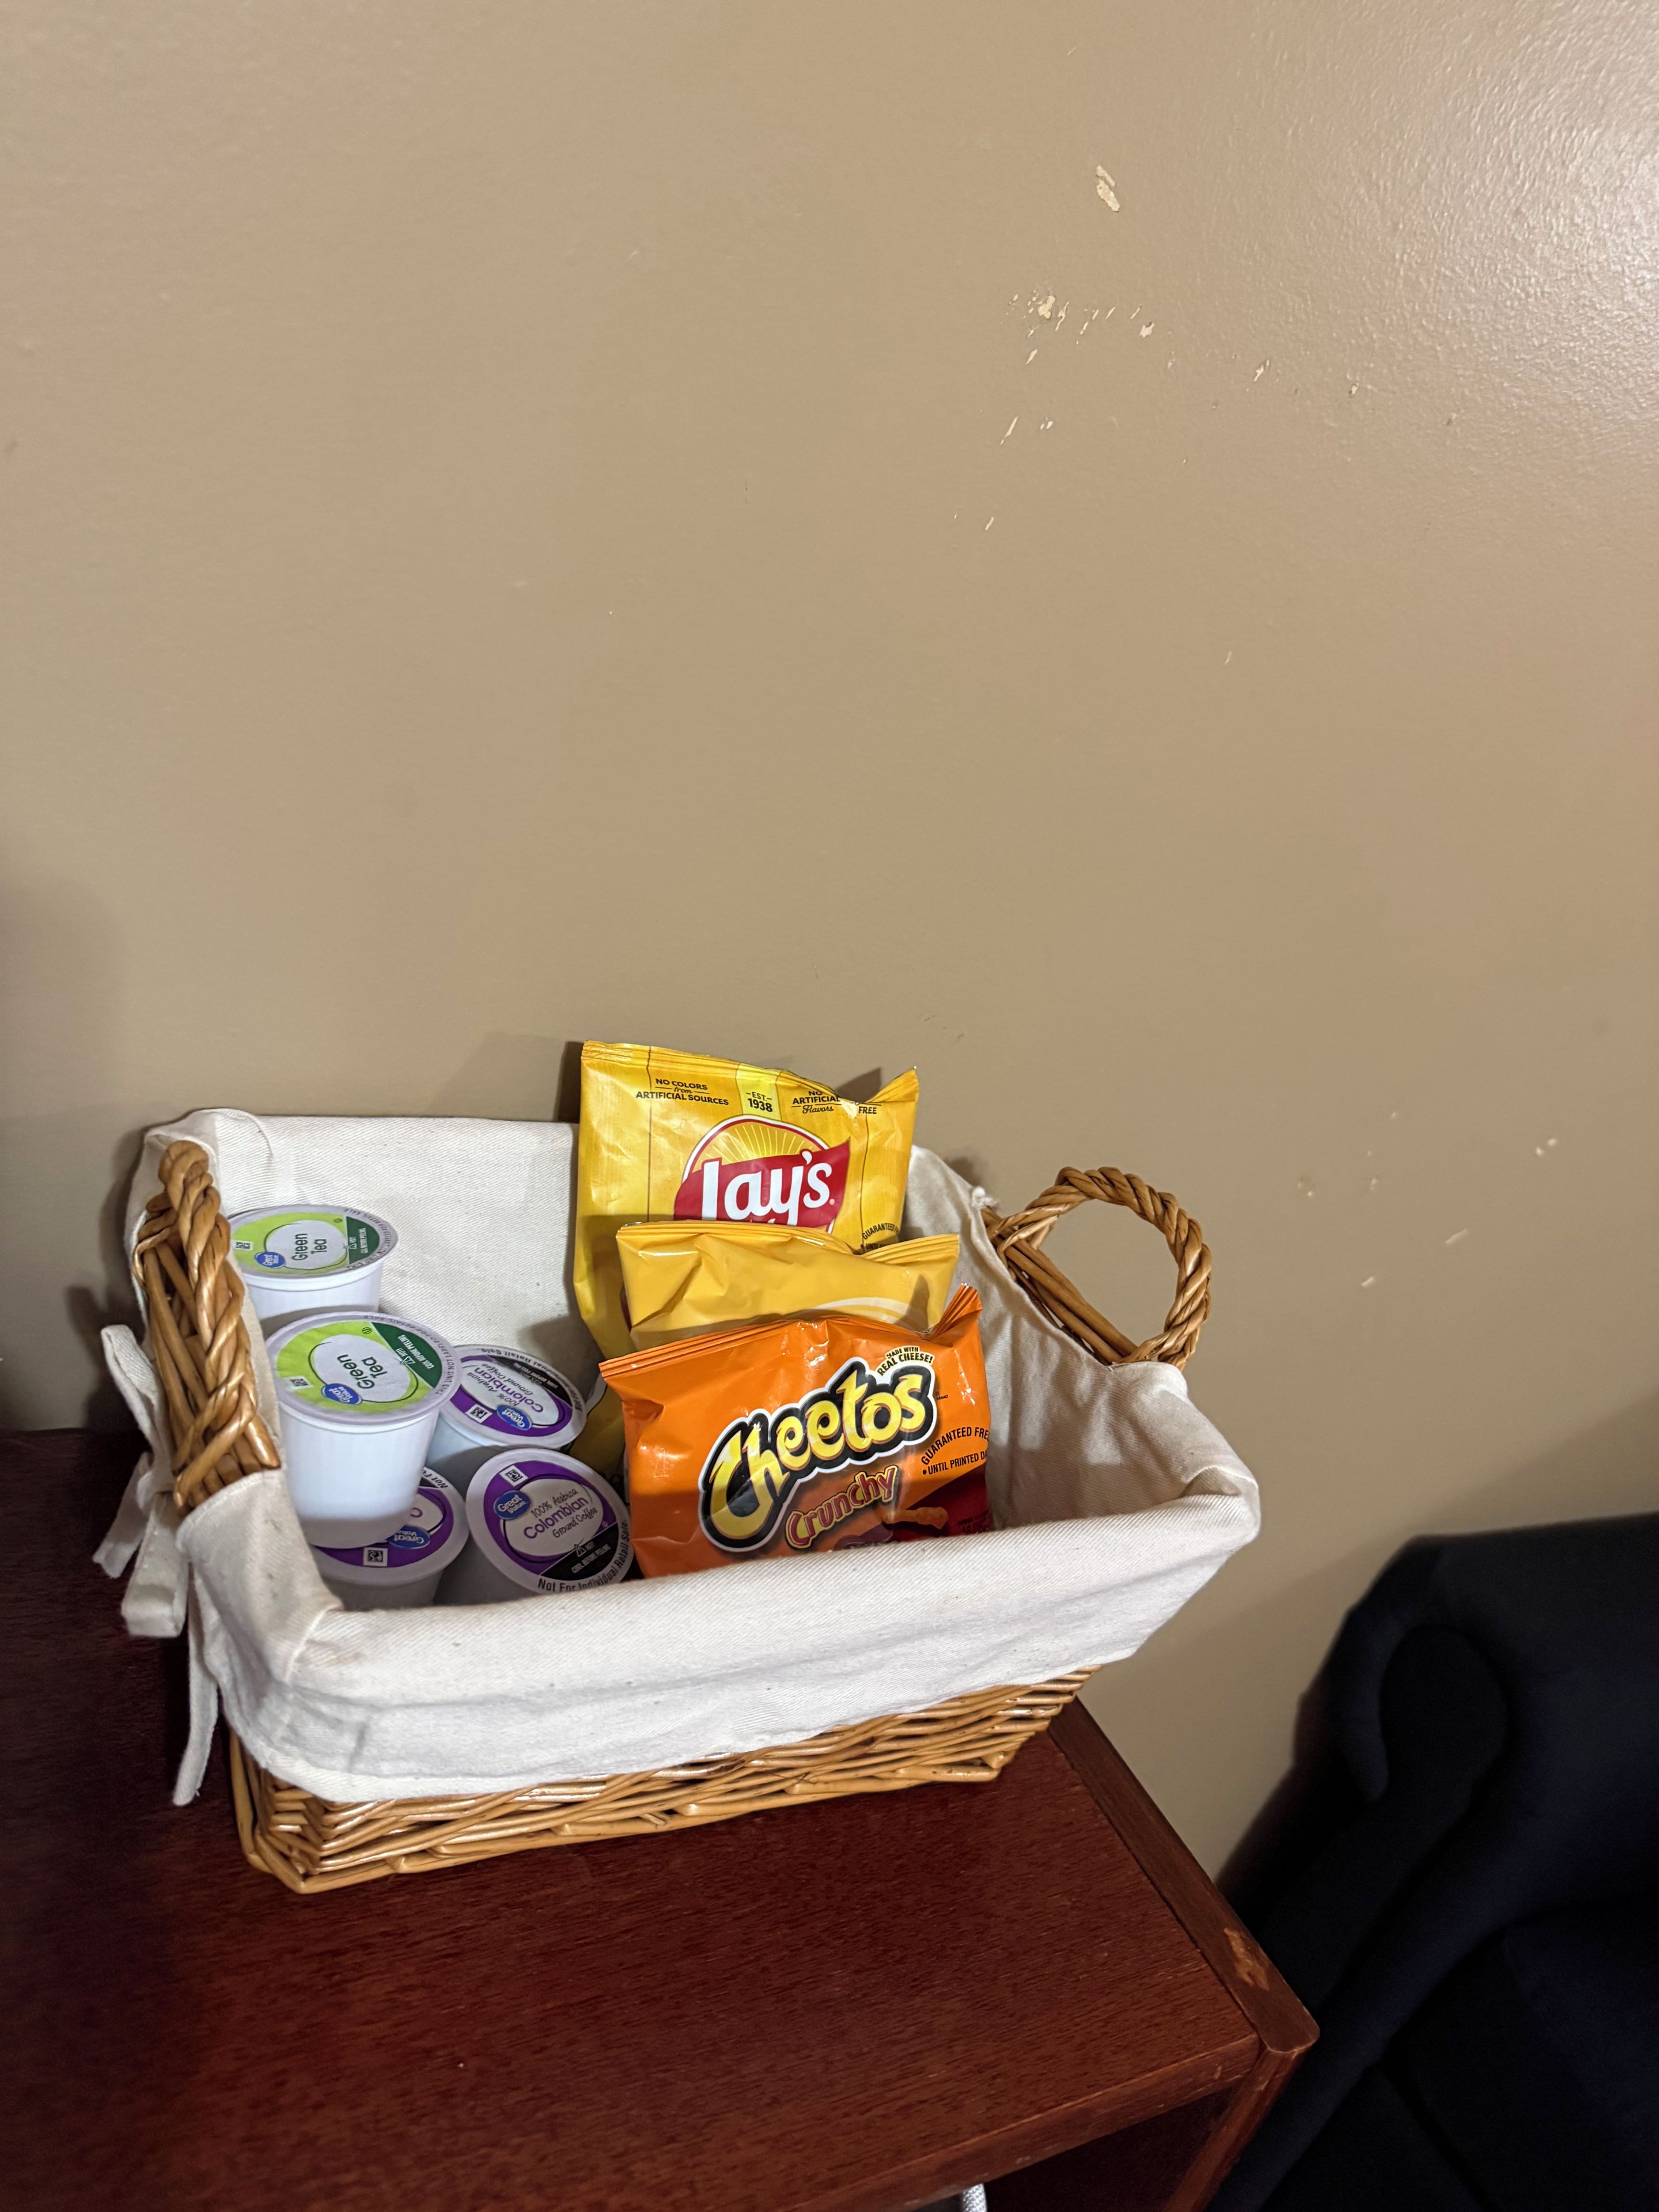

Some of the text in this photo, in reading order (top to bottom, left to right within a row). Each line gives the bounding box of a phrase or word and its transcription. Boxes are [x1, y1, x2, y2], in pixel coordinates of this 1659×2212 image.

[671, 1081, 708, 1090] COLORS
[636, 1091, 729, 1105] ARTIFICIAL SOURCES
[748, 1098, 773, 1112] 1938
[792, 1094, 841, 1104] ARTIFICIAL
[802, 1105, 834, 1114] Flavors
[858, 1106, 877, 1114] FREE
[862, 1222, 895, 1240] GUARANTEED
[291, 1233, 308, 1260] Green
[310, 1238, 327, 1255] Tea
[886, 1348, 903, 1359] MADE
[336, 1354, 375, 1389] Green
[361, 1357, 388, 1378] Tea
[446, 1359, 455, 1370] NOT
[877, 1353, 933, 1376] REAL CHEESE!
[467, 1372, 520, 1406] 100% Arabica
[474, 1367, 544, 1412] Colombian
[506, 1377, 533, 1395] Ground
[502, 1410, 525, 1428] Great
[709, 1369, 925, 1540] Cheetos
[921, 1426, 972, 1465] GUARANTEED
[927, 1461, 949, 1475] UNTIL
[950, 1453, 979, 1468] PRINTED
[431, 1476, 449, 1488] Not
[497, 1494, 523, 1512] Great
[531, 1500, 552, 1518] 100%
[786, 1466, 898, 1548] Crunchy
[523, 1497, 589, 1539] Colombian
[552, 1516, 579, 1538] Ground
[394, 1534, 425, 1544] Great
[537, 1578, 556, 1592] Not
[559, 1582, 575, 1592] For
[613, 1542, 629, 1569] Retail
